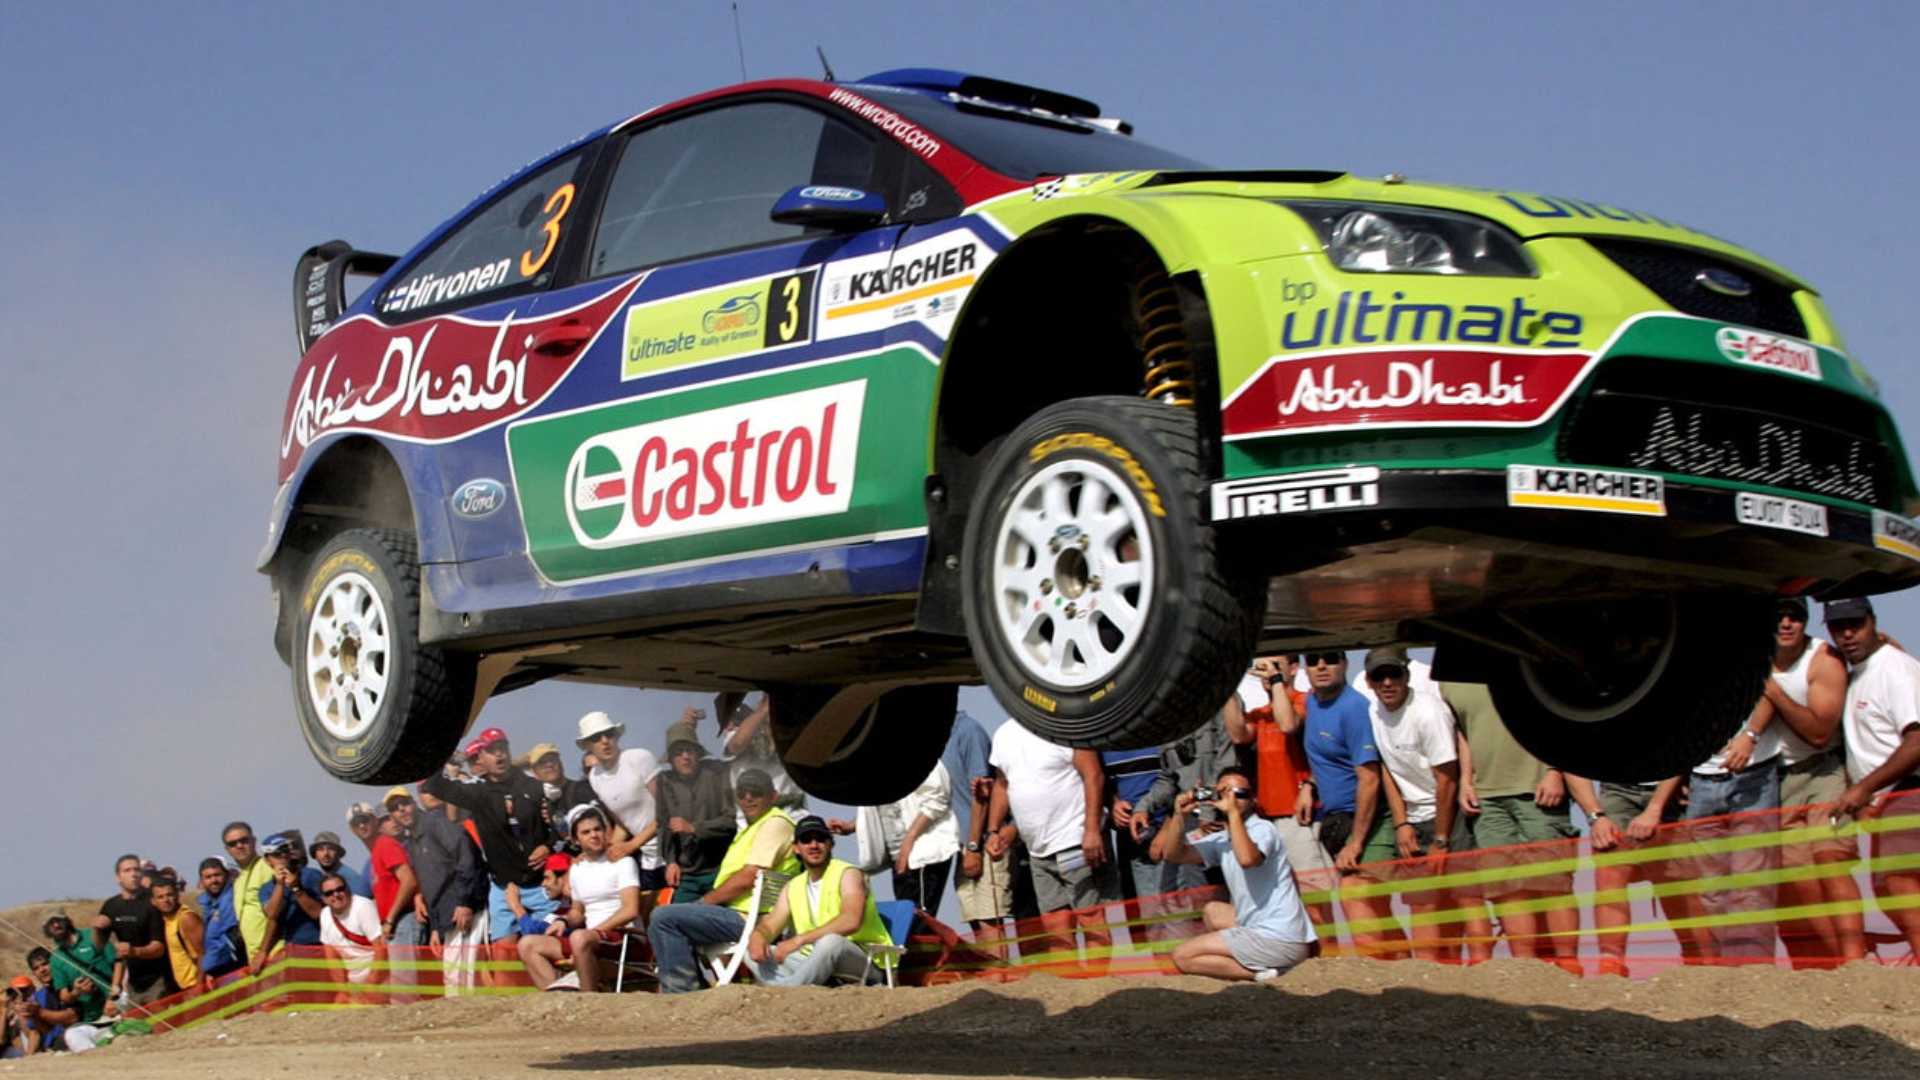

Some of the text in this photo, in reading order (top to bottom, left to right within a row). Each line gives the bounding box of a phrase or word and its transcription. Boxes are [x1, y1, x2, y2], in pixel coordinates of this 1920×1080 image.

[520, 183, 575, 277] 3
[401, 258, 512, 312] Hirvonen
[849, 243, 977, 301] KÄRCHER
[1282, 278, 1317, 306] bp
[778, 276, 802, 342] 3
[1281, 290, 1584, 350] ultimate
[282, 309, 531, 459] Abu Dhabi
[1278, 358, 1538, 416] Abu Dhabi
[631, 402, 838, 529] Castrol
[1211, 466, 1379, 522] PIRELLI
[462, 484, 496, 512] Ford
